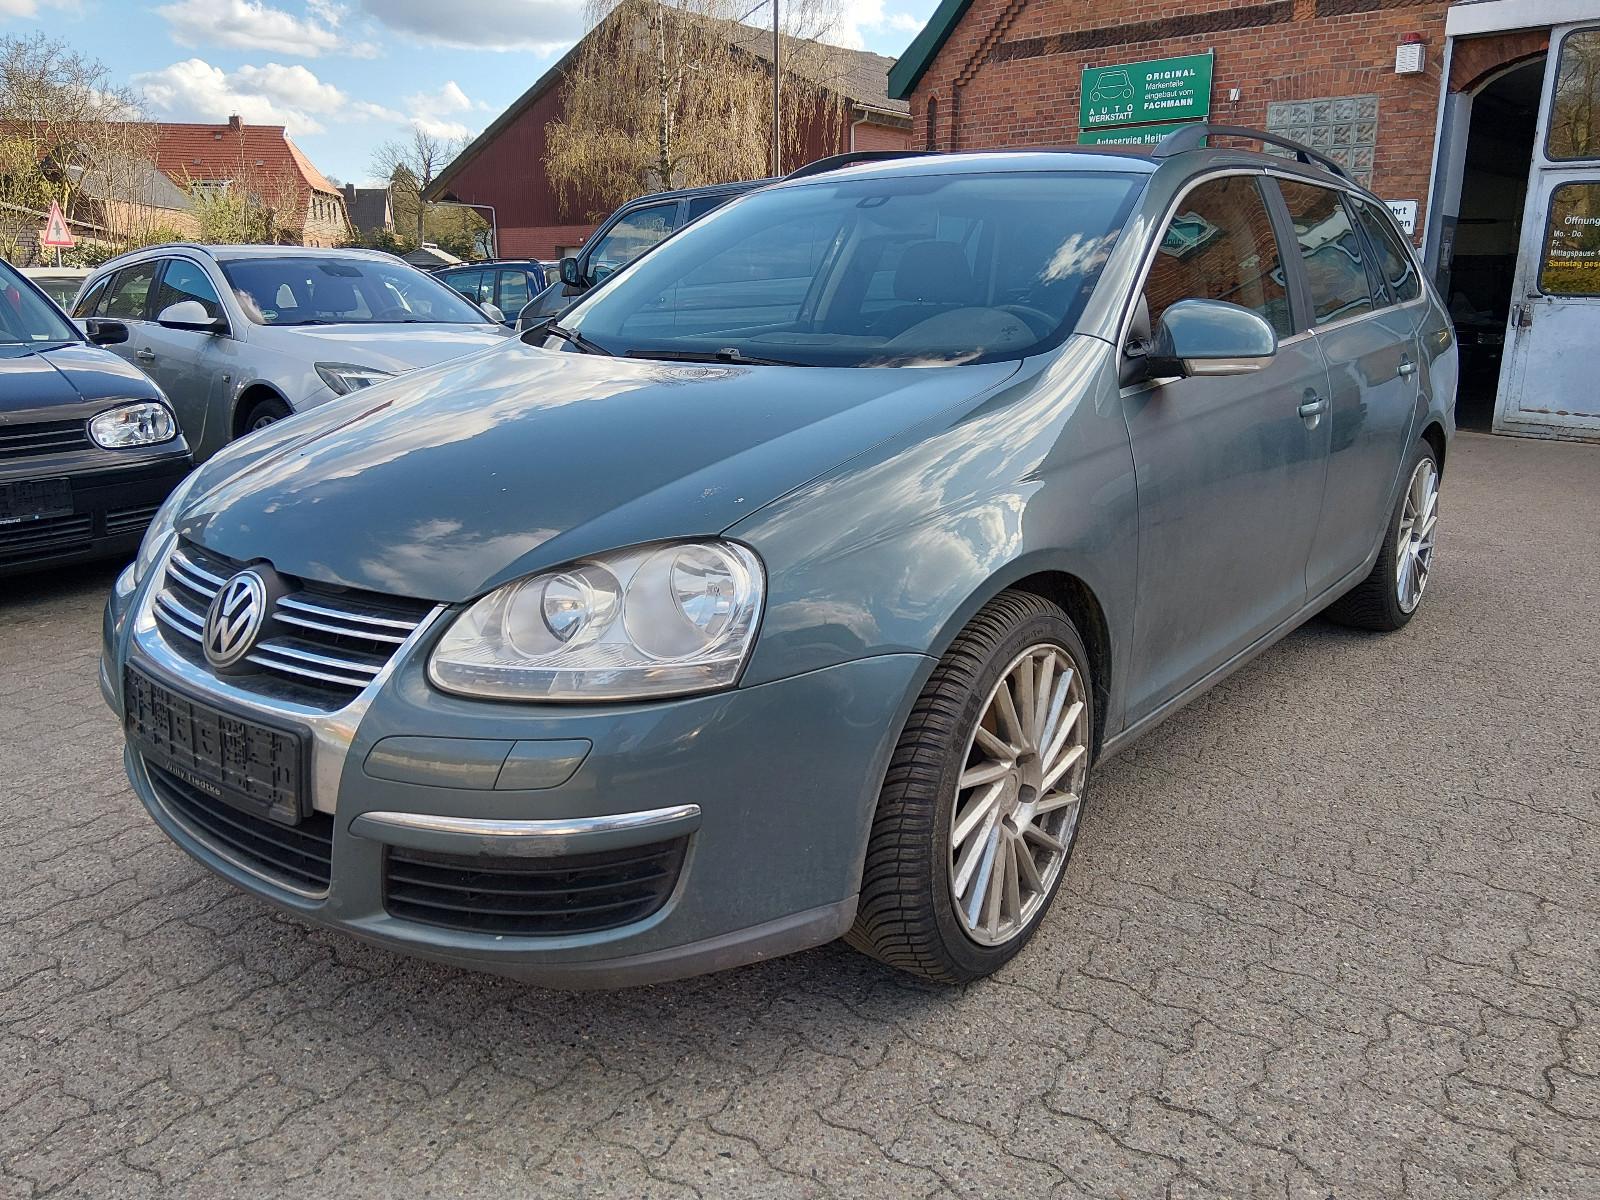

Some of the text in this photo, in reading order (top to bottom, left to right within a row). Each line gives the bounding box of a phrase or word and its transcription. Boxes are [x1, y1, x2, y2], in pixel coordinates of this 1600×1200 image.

[1146, 69, 1195, 80] ORIGINAL
[1146, 80, 1184, 90] Markenteile
[1145, 91, 1177, 100] eingebaut
[1144, 98, 1193, 109] FACHMANN
[1089, 112, 1133, 122] WERKSTATT
[1551, 239, 1561, 247] Fr.
[1551, 250, 1595, 258] Mittagspause
[1548, 260, 1582, 268] Samstag
